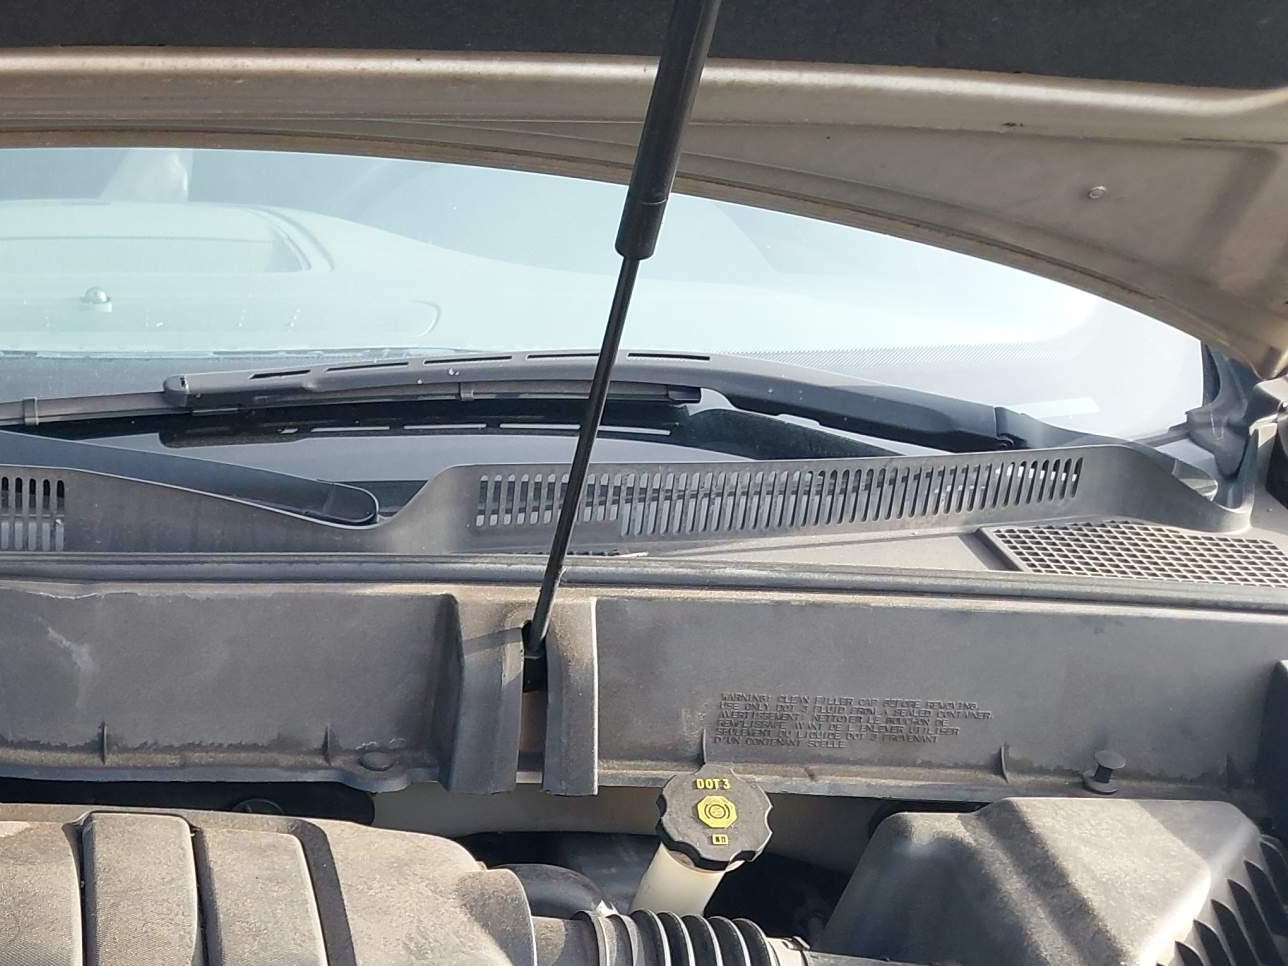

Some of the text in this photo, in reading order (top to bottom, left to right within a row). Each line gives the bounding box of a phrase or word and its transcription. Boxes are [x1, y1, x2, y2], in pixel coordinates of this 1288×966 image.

[777, 694, 809, 704] CLEAN
[815, 695, 854, 705] FILLER
[719, 701, 741, 710] USE
[744, 702, 769, 711] ONLY
[775, 703, 797, 712] DOT
[814, 705, 847, 714] FLUID
[895, 708, 931, 717] SEALED
[829, 722, 843, 731] DE
[935, 717, 950, 727] DE
[696, 778, 731, 790] DOT 3
